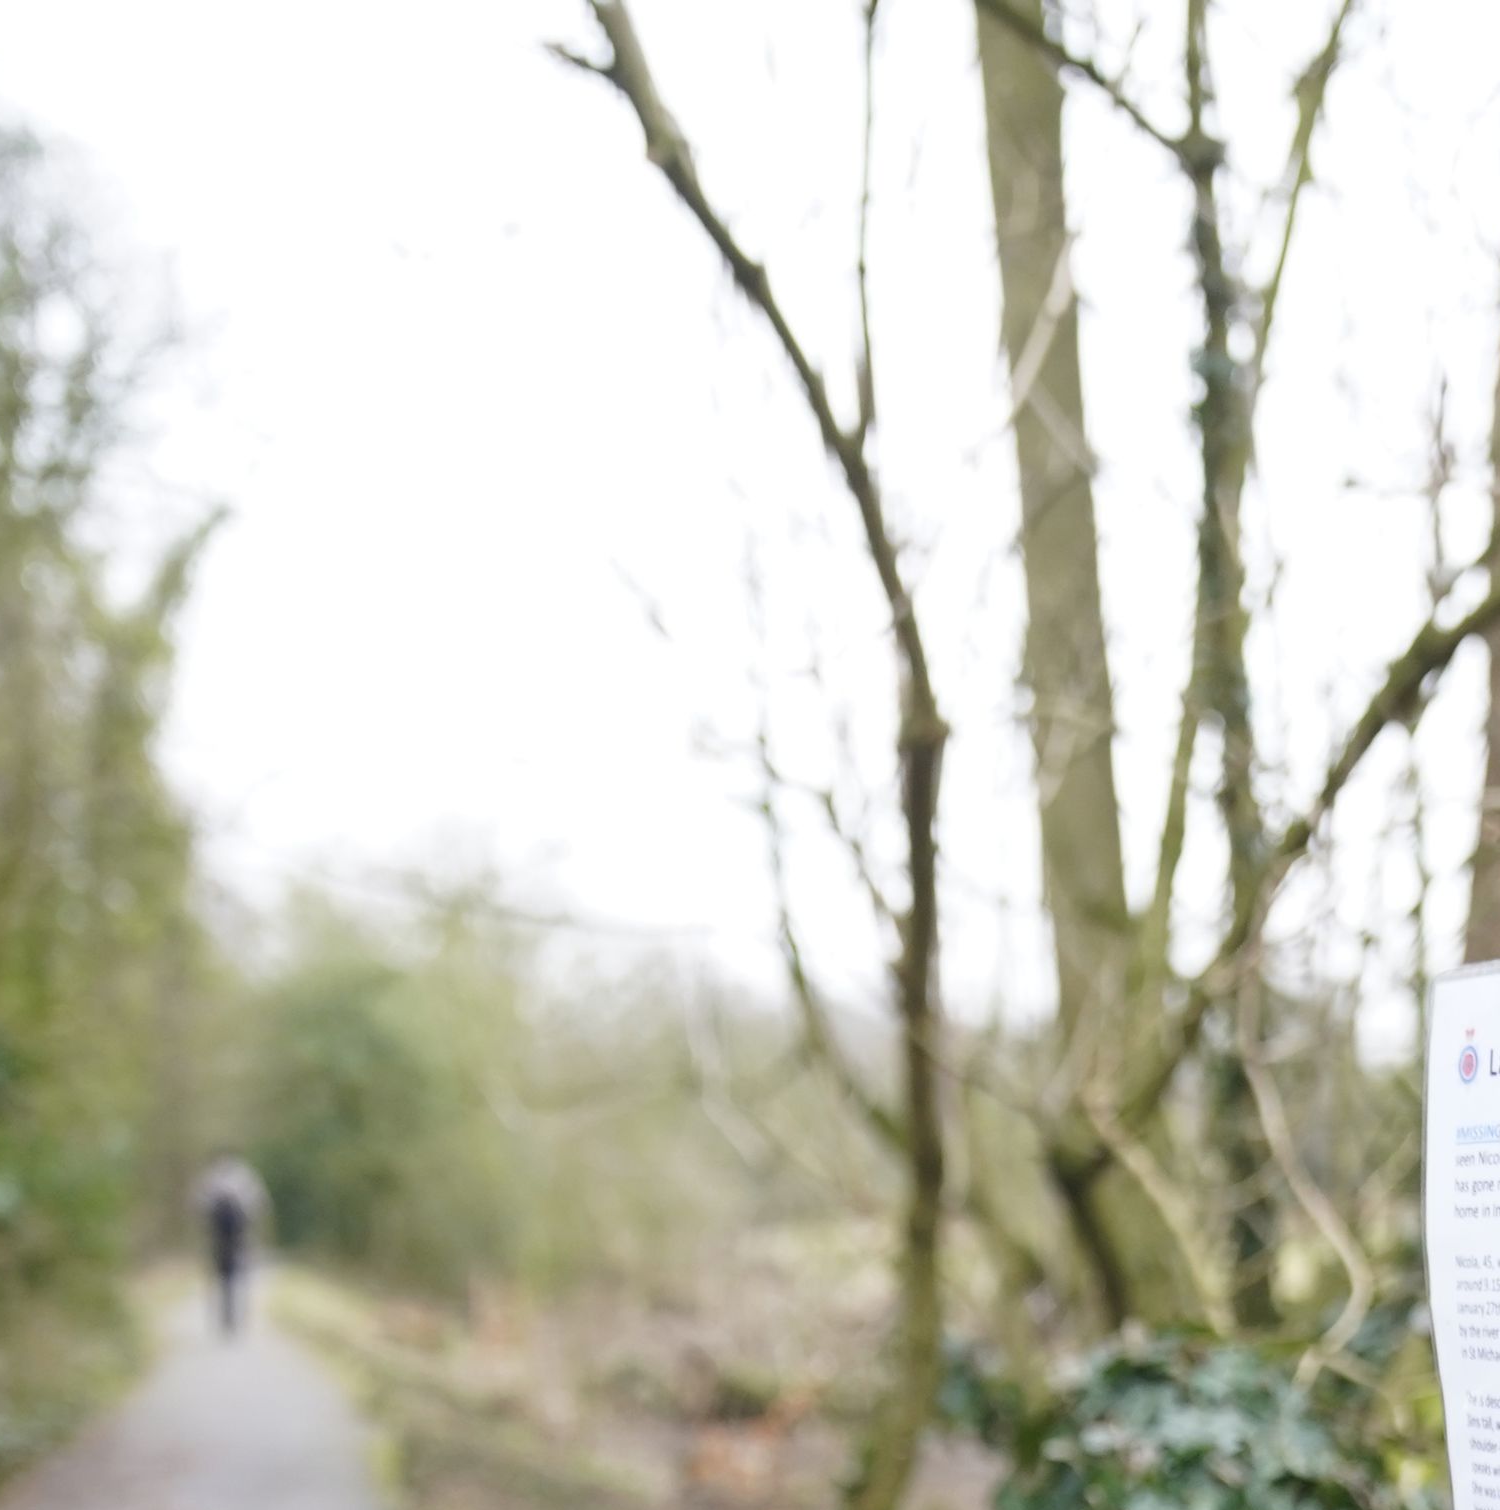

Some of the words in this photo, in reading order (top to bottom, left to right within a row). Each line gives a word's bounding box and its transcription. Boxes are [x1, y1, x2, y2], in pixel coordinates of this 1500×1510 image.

[1454, 1178, 1470, 1193] has
[1471, 1179, 1494, 1196] gone
[1454, 1204, 1479, 1219] home
[1482, 1204, 1491, 1218] in
